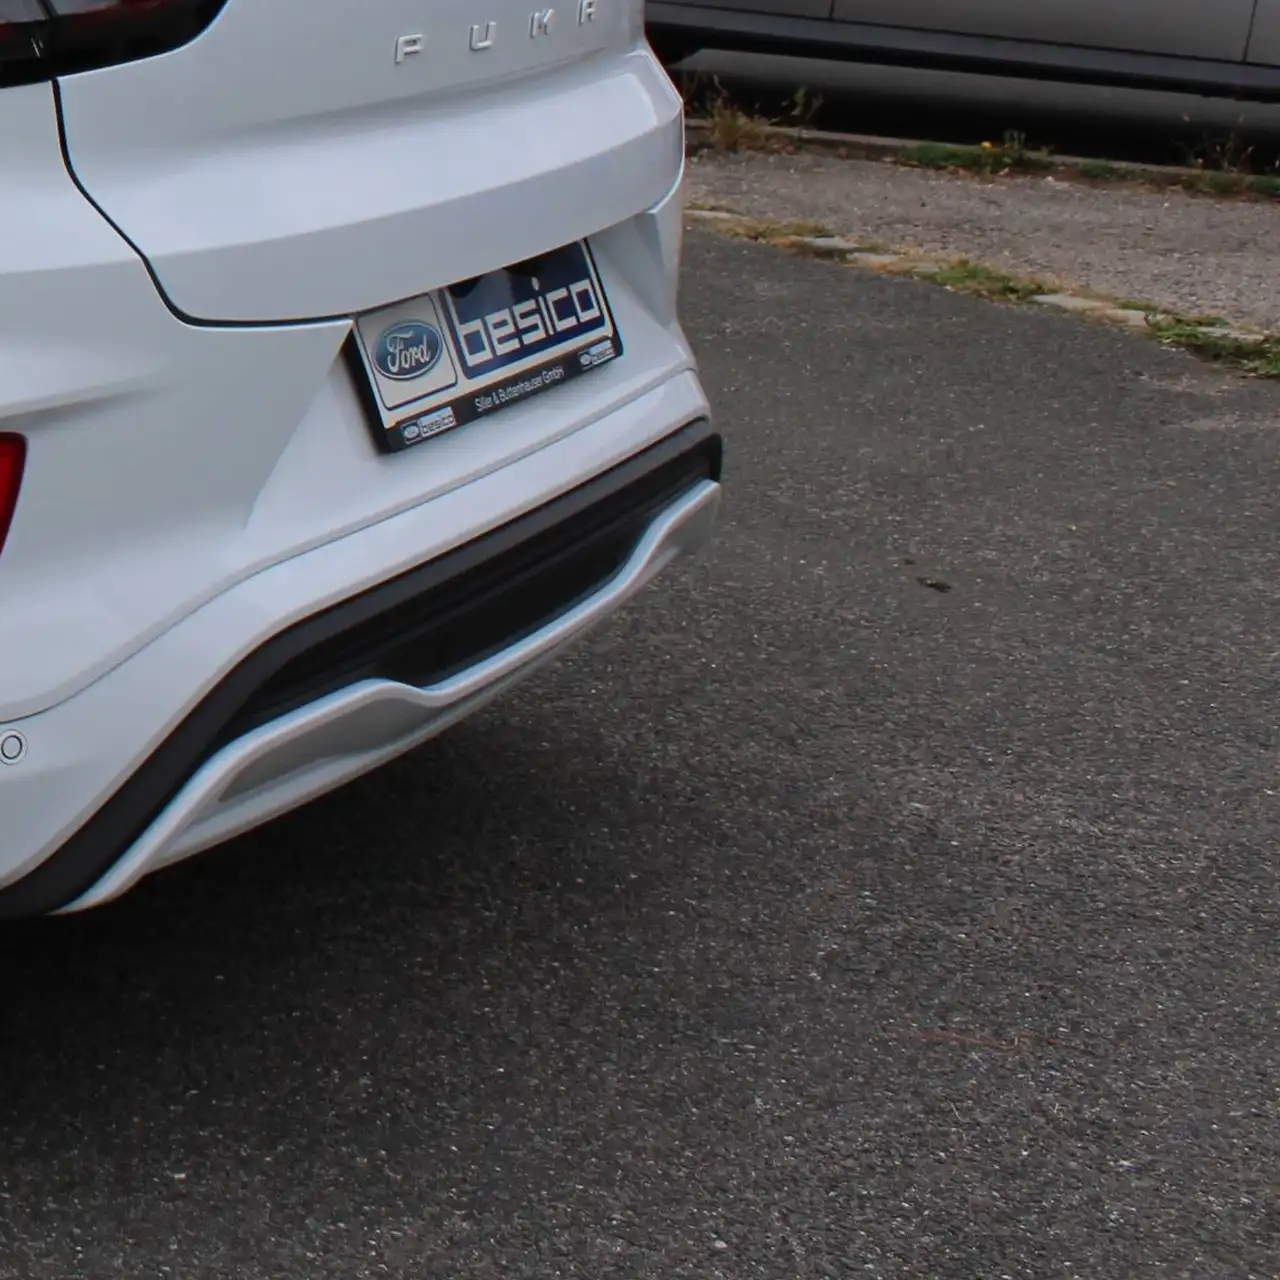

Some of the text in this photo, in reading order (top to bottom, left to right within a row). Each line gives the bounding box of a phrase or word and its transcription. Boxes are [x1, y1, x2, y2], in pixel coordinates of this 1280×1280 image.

[455, 276, 601, 368] besico
[385, 330, 432, 372] Ford
[542, 365, 565, 384] GmbH
